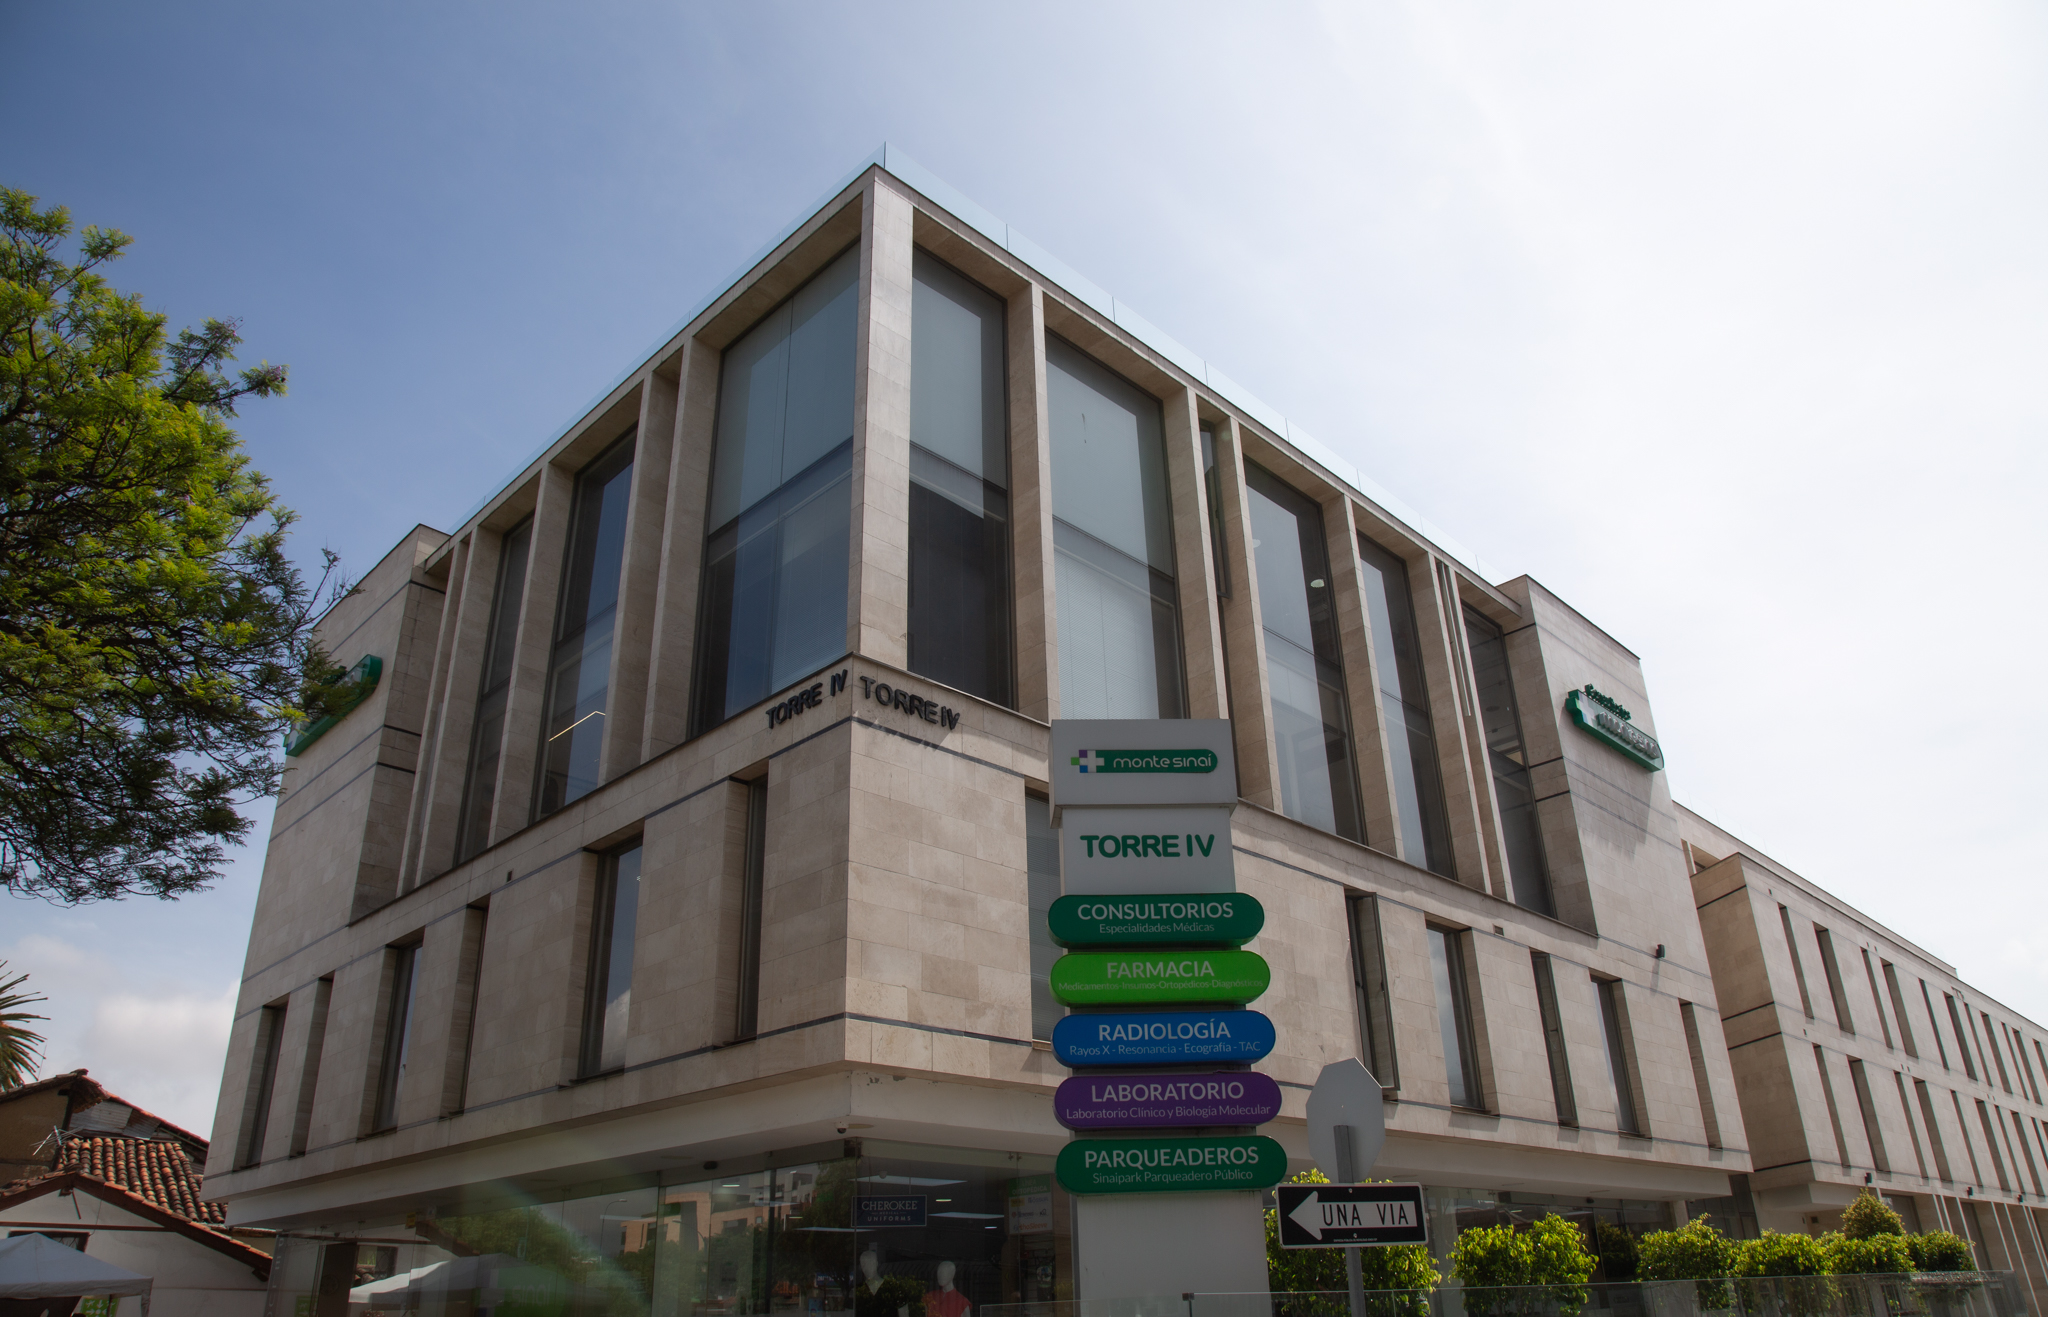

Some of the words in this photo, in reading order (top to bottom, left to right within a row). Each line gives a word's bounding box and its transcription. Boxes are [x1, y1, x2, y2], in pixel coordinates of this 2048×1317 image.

[766, 682, 822, 729] TORRE
[830, 669, 848, 696] IV
[860, 676, 938, 724] TORRE
[941, 706, 960, 730] IV
[1114, 755, 1170, 768] monte
[1080, 834, 1180, 858] TORRE
[1187, 834, 1214, 857] IV
[1078, 902, 1233, 920] CONSULTORIOS
[1100, 923, 1171, 935] Especialidades
[1173, 922, 1214, 932] Médicas
[1107, 961, 1214, 978] FARMACIA
[1099, 1019, 1231, 1041] RADIOLOGÍA
[1070, 1045, 1100, 1057] Rayos
[1102, 1045, 1110, 1055] X
[1118, 1044, 1176, 1054] Resonancia
[1185, 1042, 1232, 1055] Ecografía
[1239, 1042, 1260, 1052] TAC
[1092, 1082, 1244, 1102] LABORATORIO
[1067, 1108, 1128, 1119] Laboratorio
[1130, 1107, 1165, 1118] Clínico
[1167, 1110, 1173, 1119] y
[1176, 1106, 1217, 1119] Biología
[1219, 1104, 1271, 1116] Molecular
[1085, 1147, 1259, 1170] PARQUEADEROS
[1093, 1172, 1141, 1185] Sinaipark
[1145, 1171, 1212, 1184] Parqueadero
[1215, 1170, 1253, 1180] Público
[862, 1201, 917, 1210] CHEROKEE
[1322, 1204, 1361, 1226] UNA
[1376, 1203, 1409, 1225] VIA
